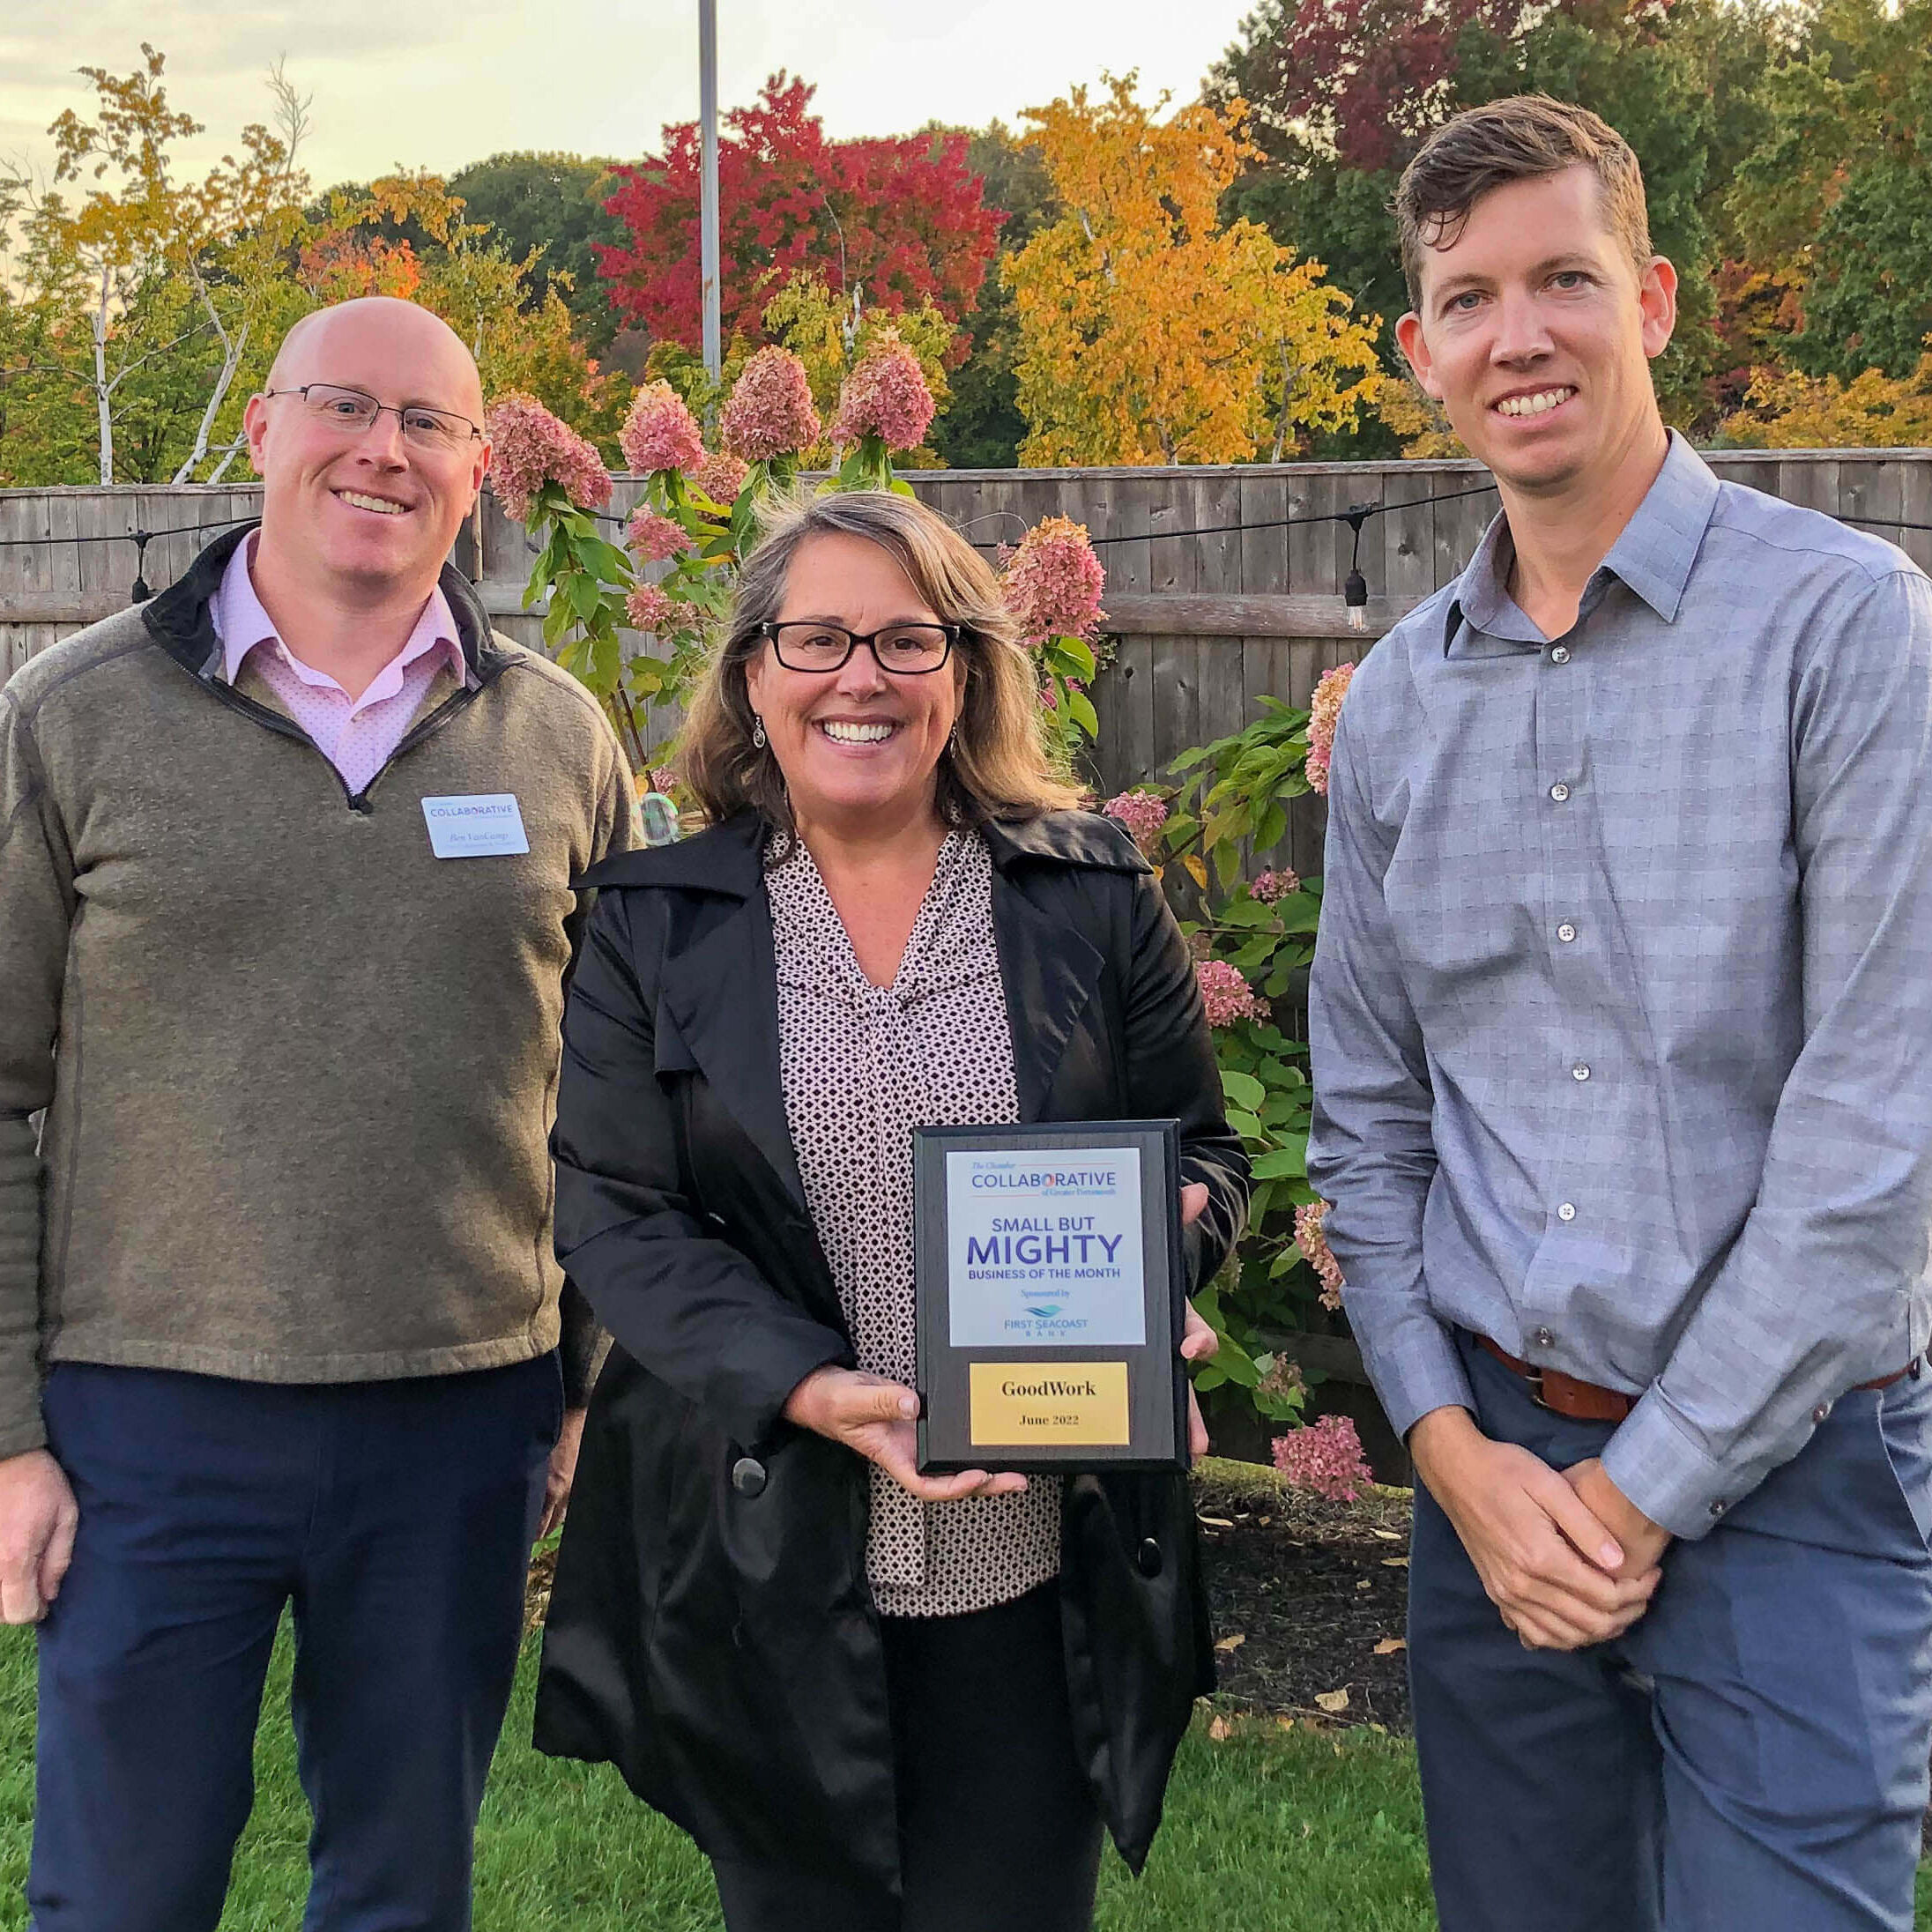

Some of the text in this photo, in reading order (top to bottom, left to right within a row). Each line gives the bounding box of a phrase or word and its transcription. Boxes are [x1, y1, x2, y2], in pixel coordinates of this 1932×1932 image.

[430, 804, 513, 818] COLLABORATIVE
[971, 1171, 1116, 1188] COLLABORATIVE
[992, 1216, 1095, 1232] SMALL BUT
[967, 1234, 1123, 1265] MIGHTY
[969, 1267, 1120, 1280] BUSINESS OF THE MONTH
[1004, 1319, 1089, 1329] FIRST SEACOAST
[1001, 1380, 1096, 1397] GoodWork
[1019, 1415, 1080, 1426] June 2022
